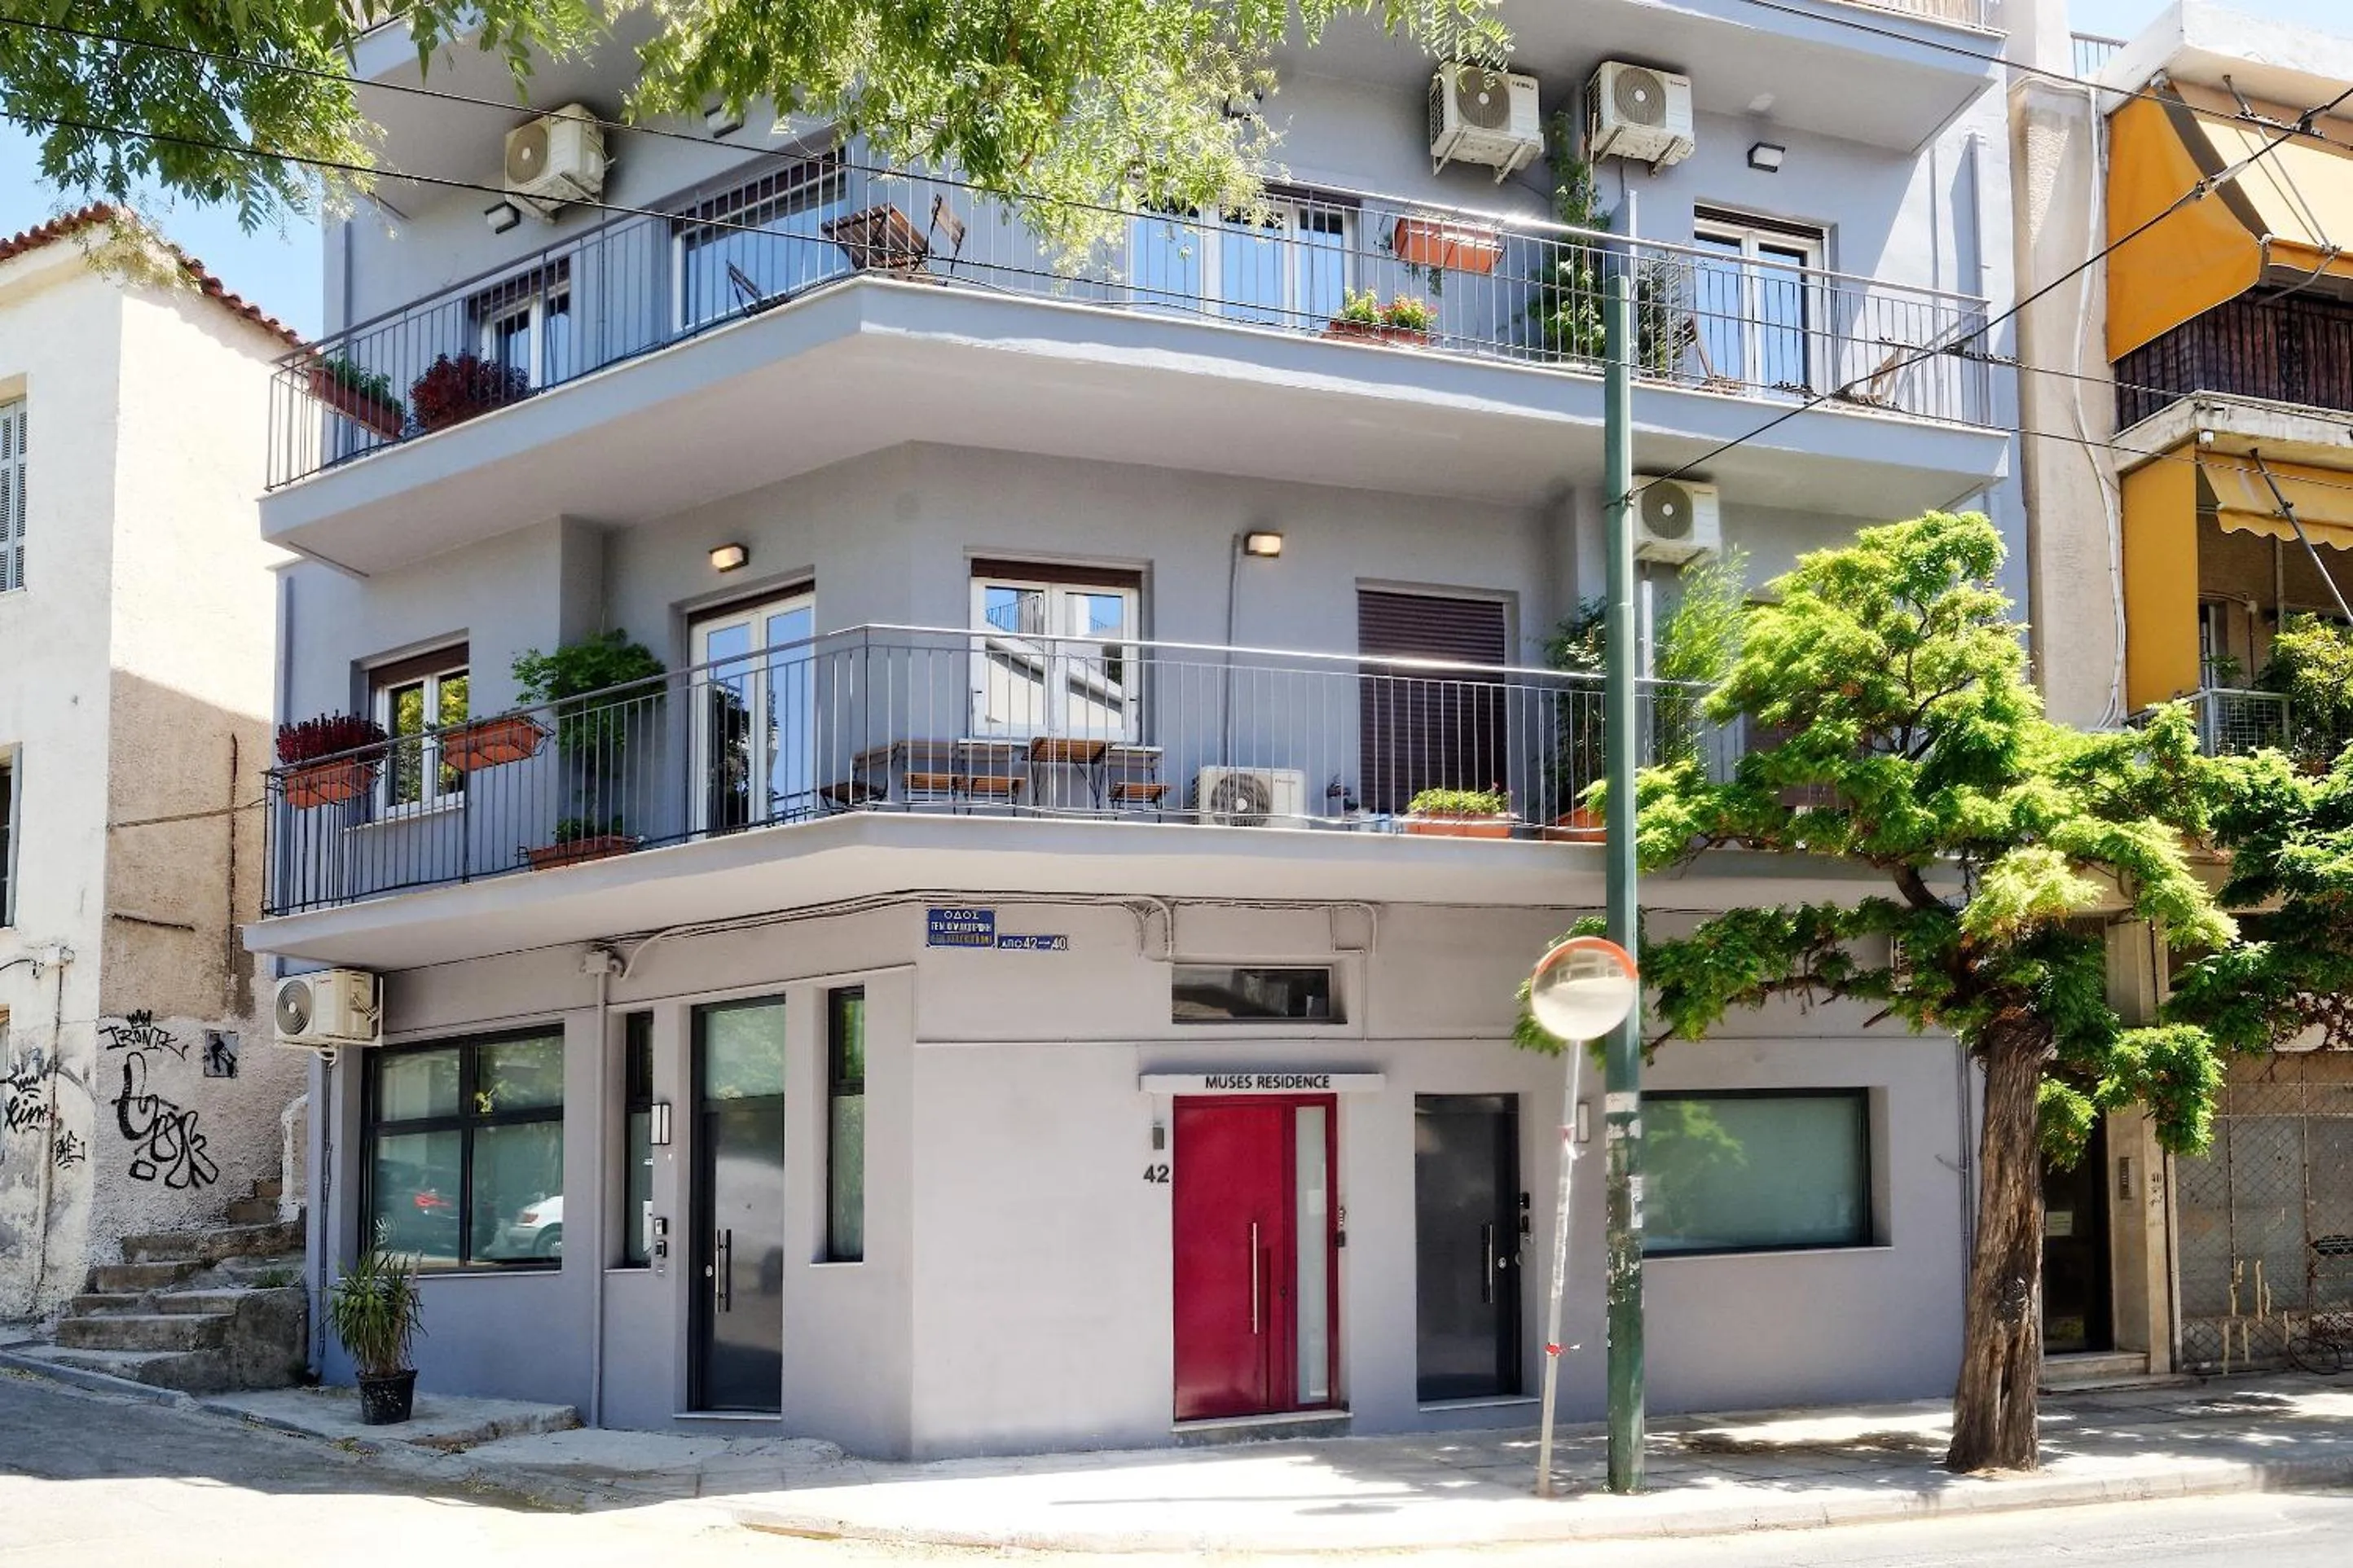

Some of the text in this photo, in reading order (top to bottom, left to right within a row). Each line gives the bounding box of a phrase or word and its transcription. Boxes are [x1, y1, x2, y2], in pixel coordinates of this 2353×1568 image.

[943, 910, 979, 920] ΟΔΟΣ
[1205, 1074, 1330, 1089] MUSES RESIDENCE
[1143, 1163, 1169, 1183] 42
